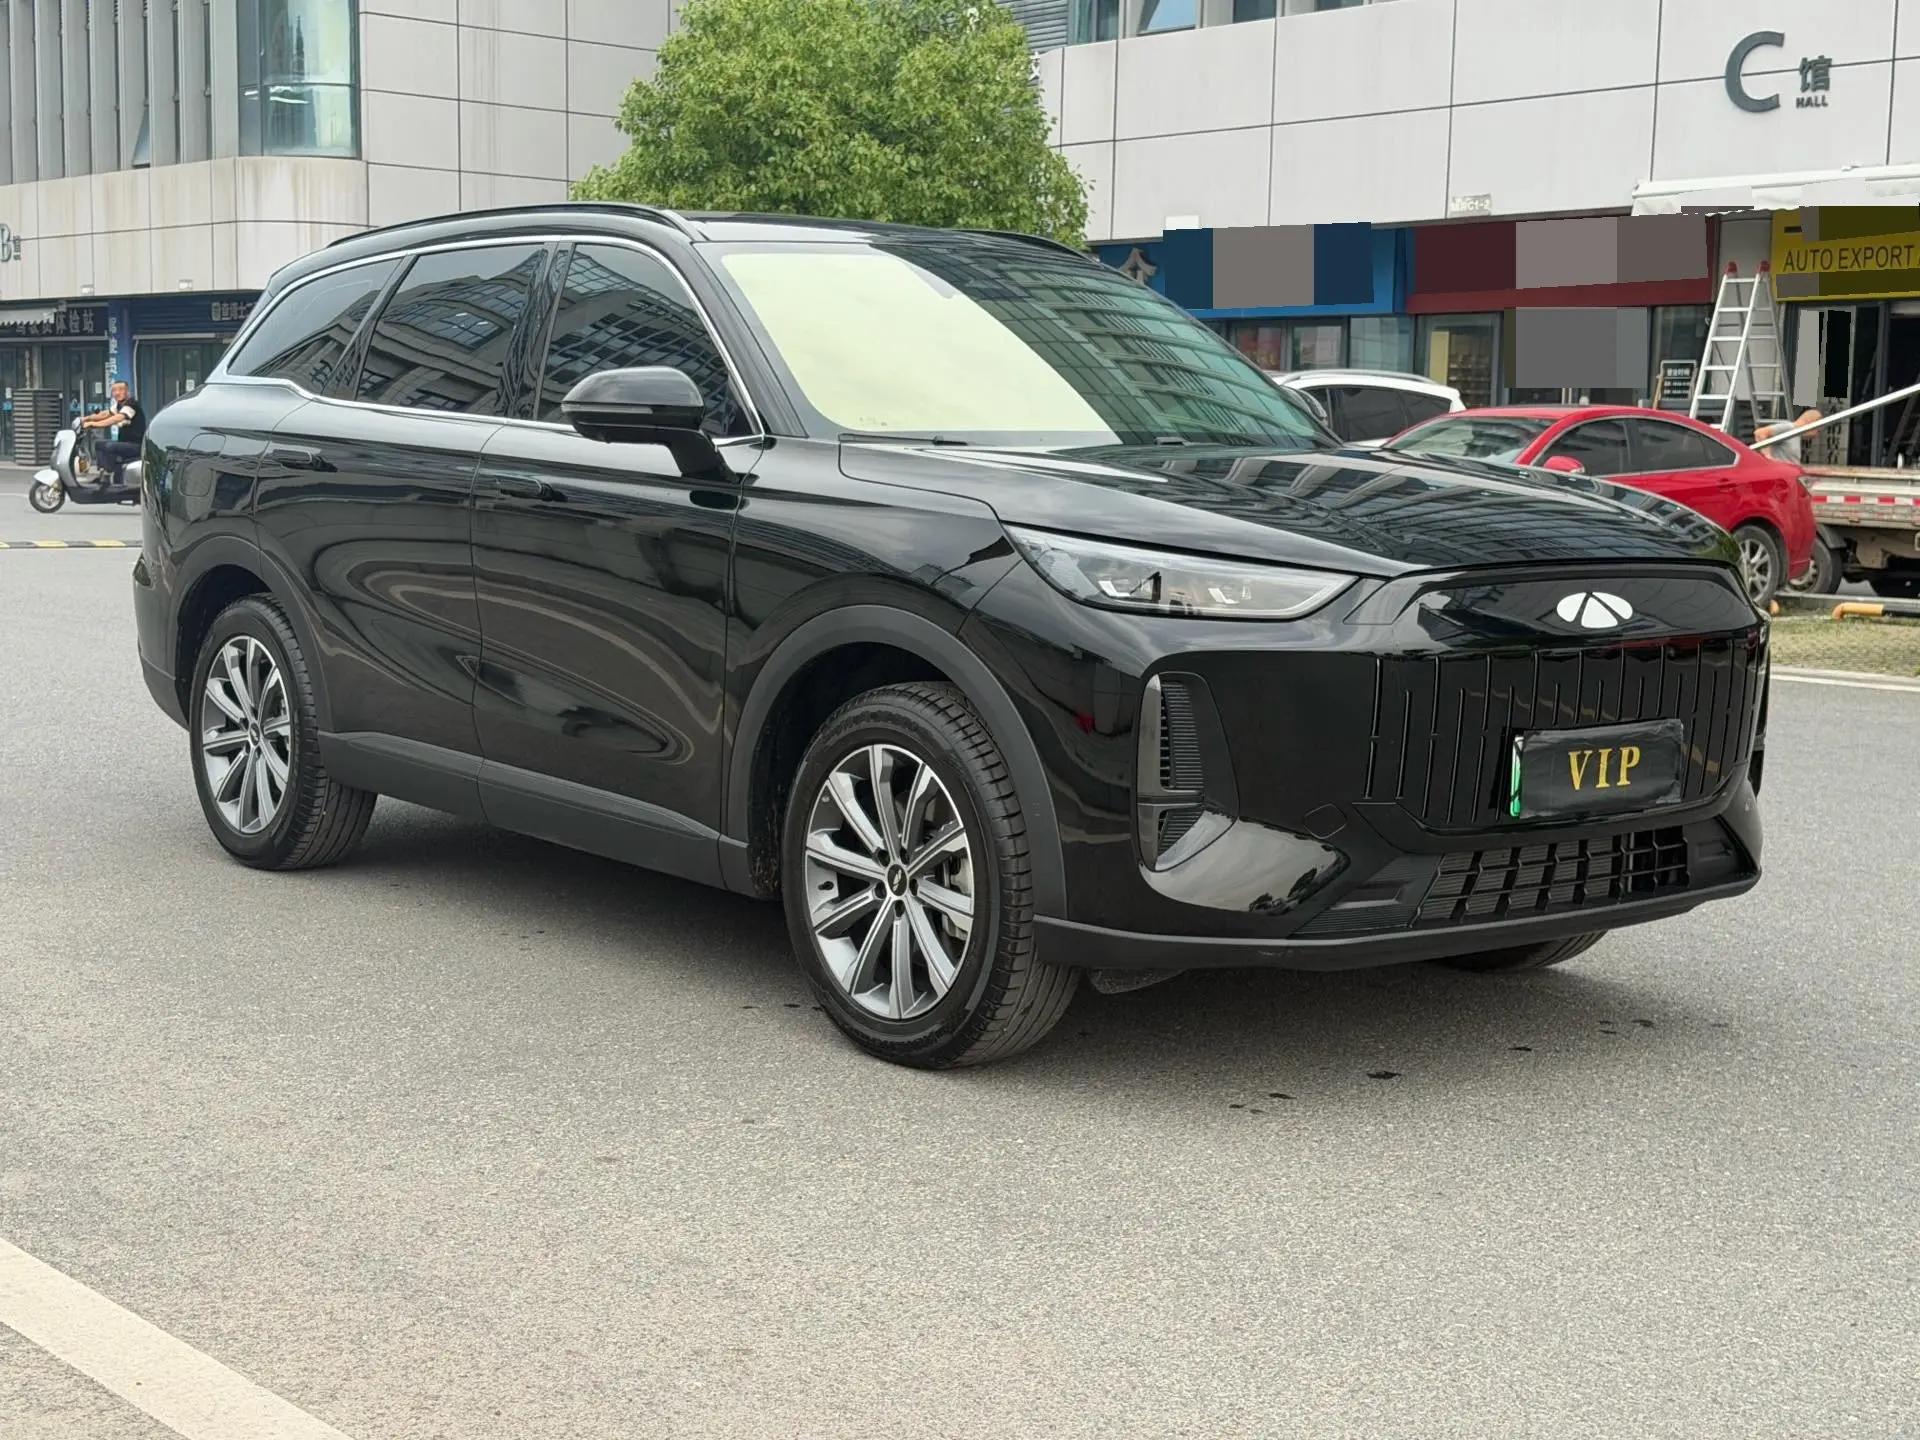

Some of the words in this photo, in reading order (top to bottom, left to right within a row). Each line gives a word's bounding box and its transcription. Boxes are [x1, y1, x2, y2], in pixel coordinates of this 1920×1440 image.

[1725, 31, 1785, 113] C
[1799, 55, 1832, 92] 馆
[1796, 95, 1828, 109] HALL
[1783, 248, 1833, 272] AUTO
[1837, 244, 1914, 270] EXPORT
[1568, 746, 1641, 791] VIP
